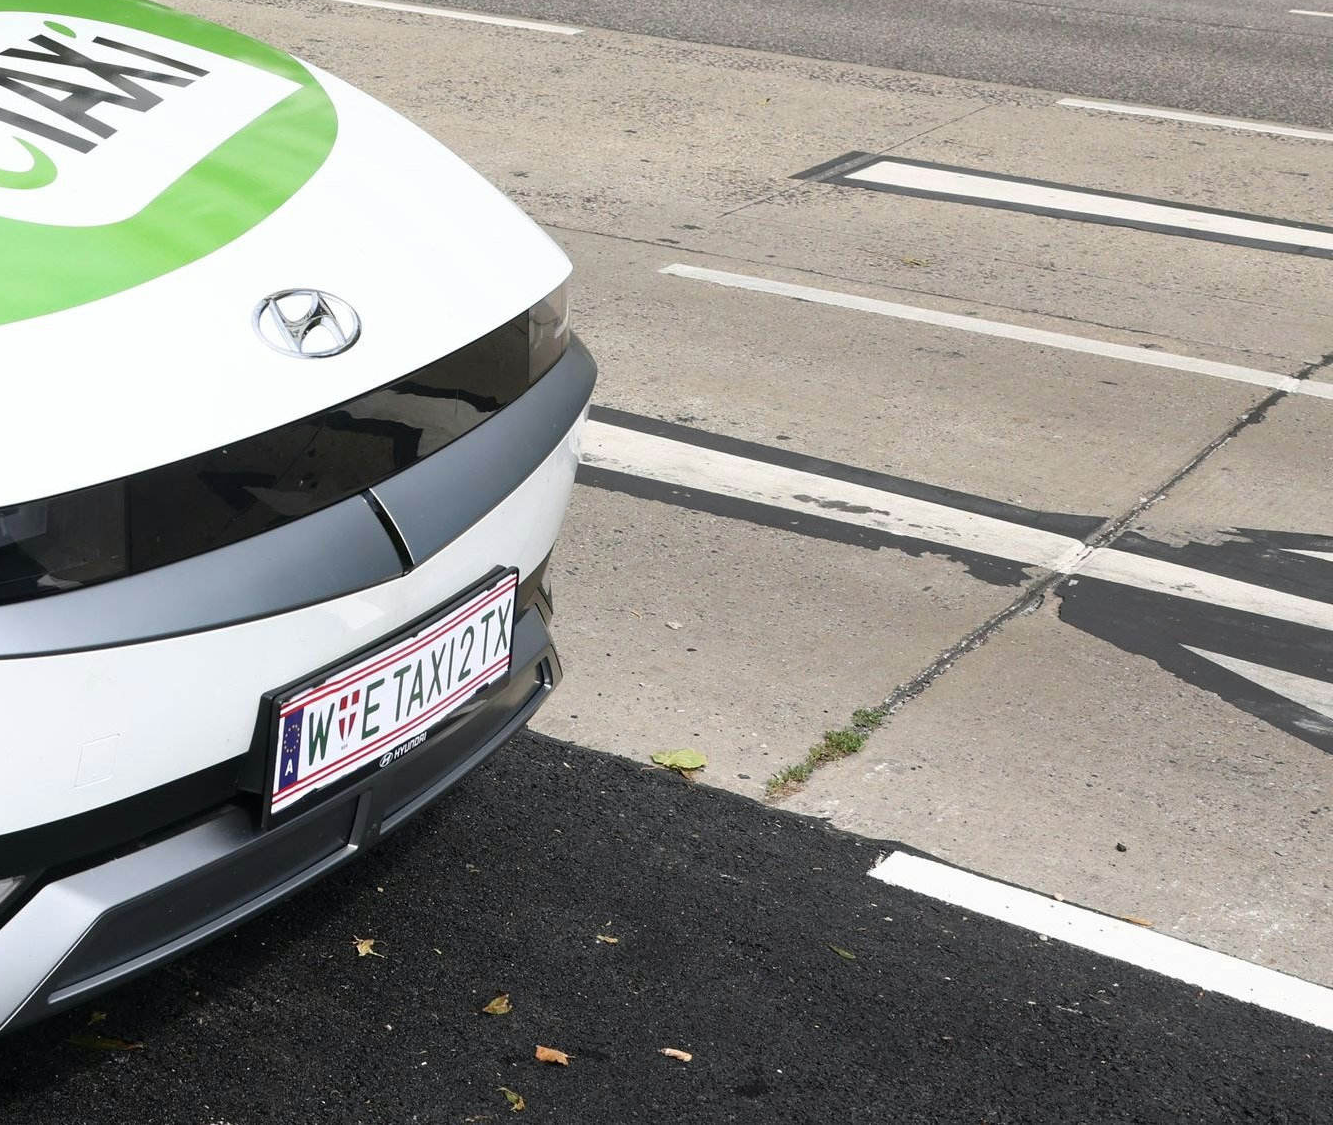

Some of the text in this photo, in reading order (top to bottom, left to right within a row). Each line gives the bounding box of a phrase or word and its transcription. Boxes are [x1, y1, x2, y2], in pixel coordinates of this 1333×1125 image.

[284, 758, 294, 777] A
[308, 702, 336, 767] W
[393, 731, 428, 759] HYUNDAI
